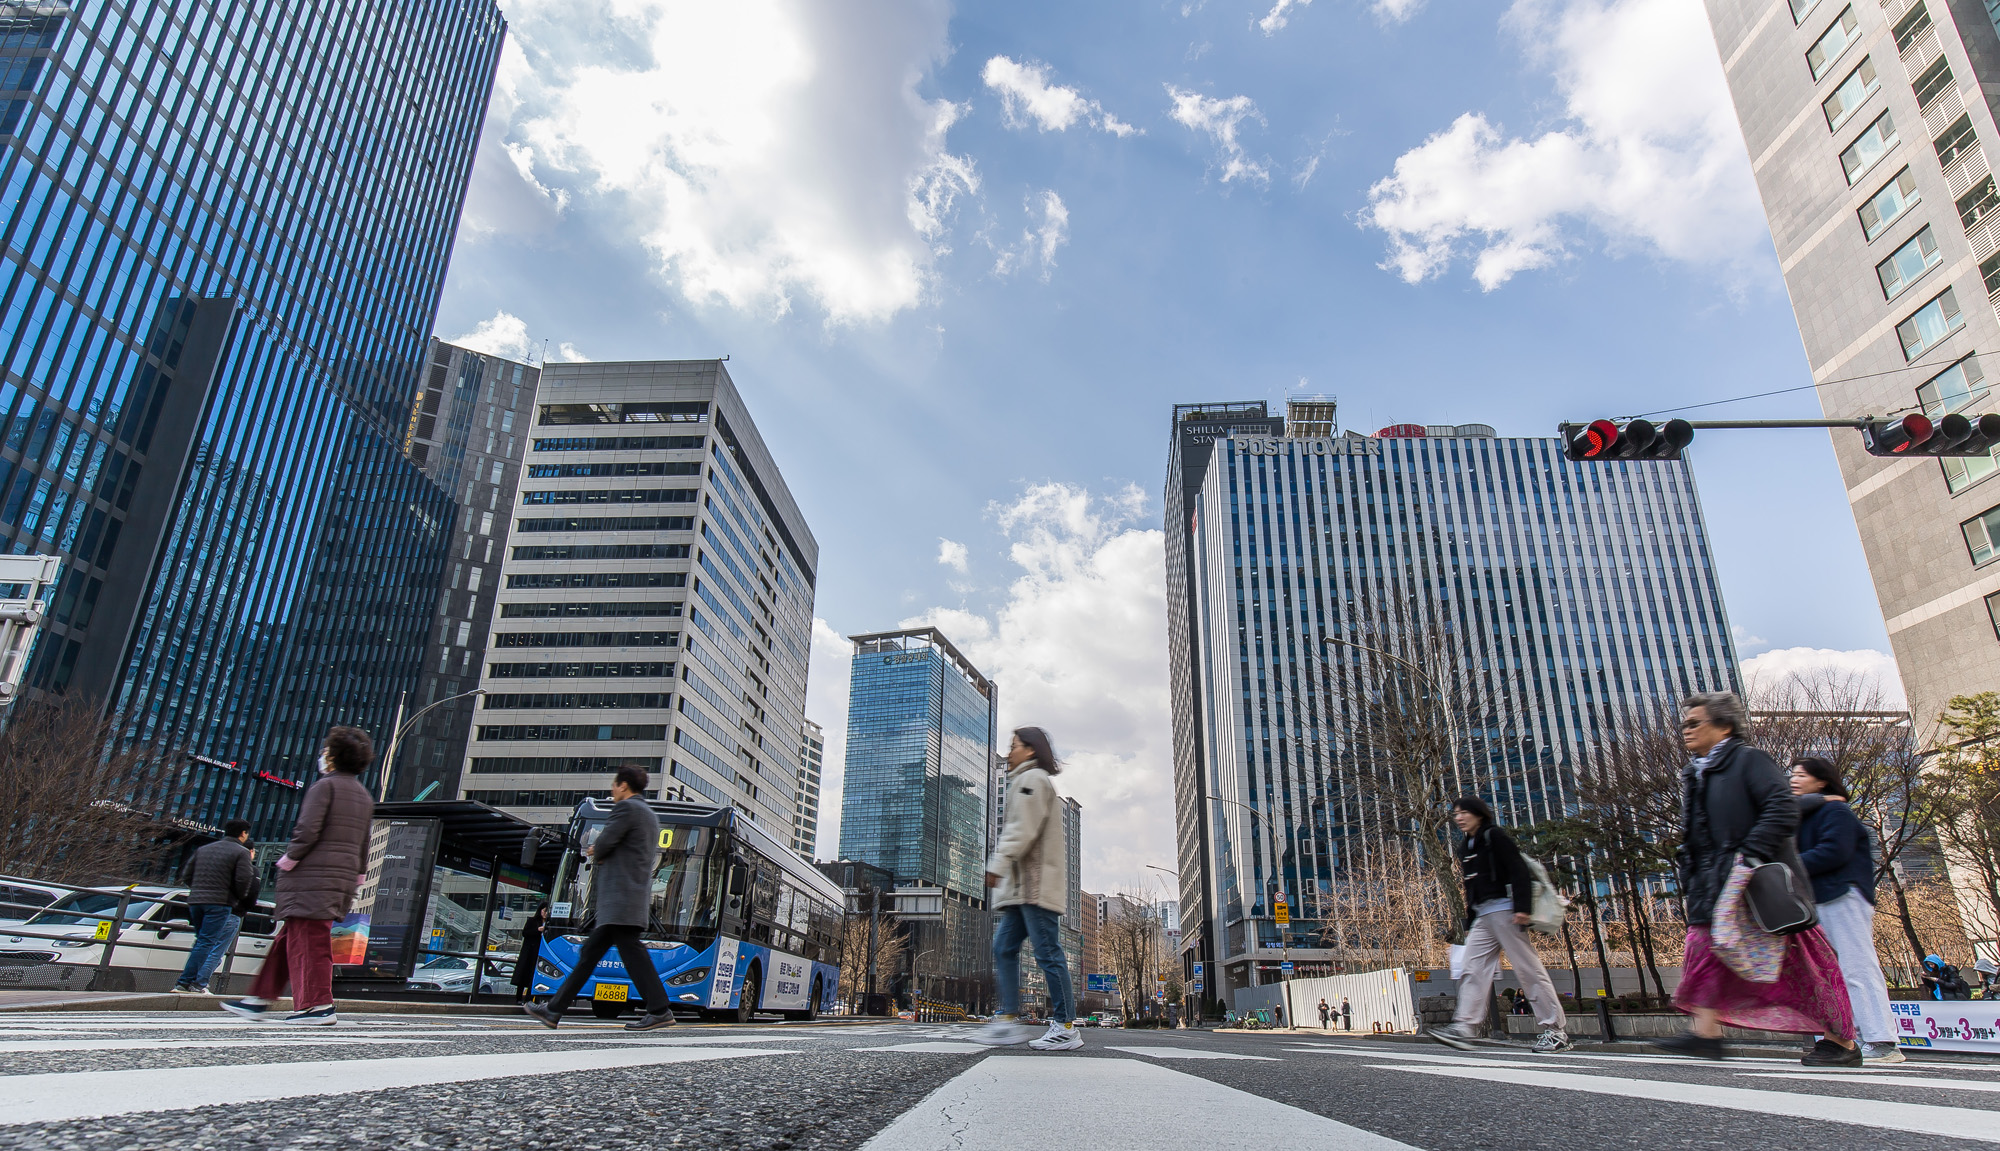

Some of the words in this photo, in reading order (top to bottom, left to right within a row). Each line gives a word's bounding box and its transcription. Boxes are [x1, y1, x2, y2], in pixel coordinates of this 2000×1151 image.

[1186, 425, 1225, 434] SHILLA
[1193, 435, 1218, 444] STAY
[1234, 438, 1291, 456] POST
[1297, 438, 1381, 456] TOWER
[893, 652, 928, 664] 경찰공제회
[196, 755, 213, 764] ASIANA
[212, 759, 232, 769] AIRLINES
[172, 816, 217, 832] LAGRILLIA
[658, 829, 673, 848] 0
[1895, 1018, 1916, 1035] 택
